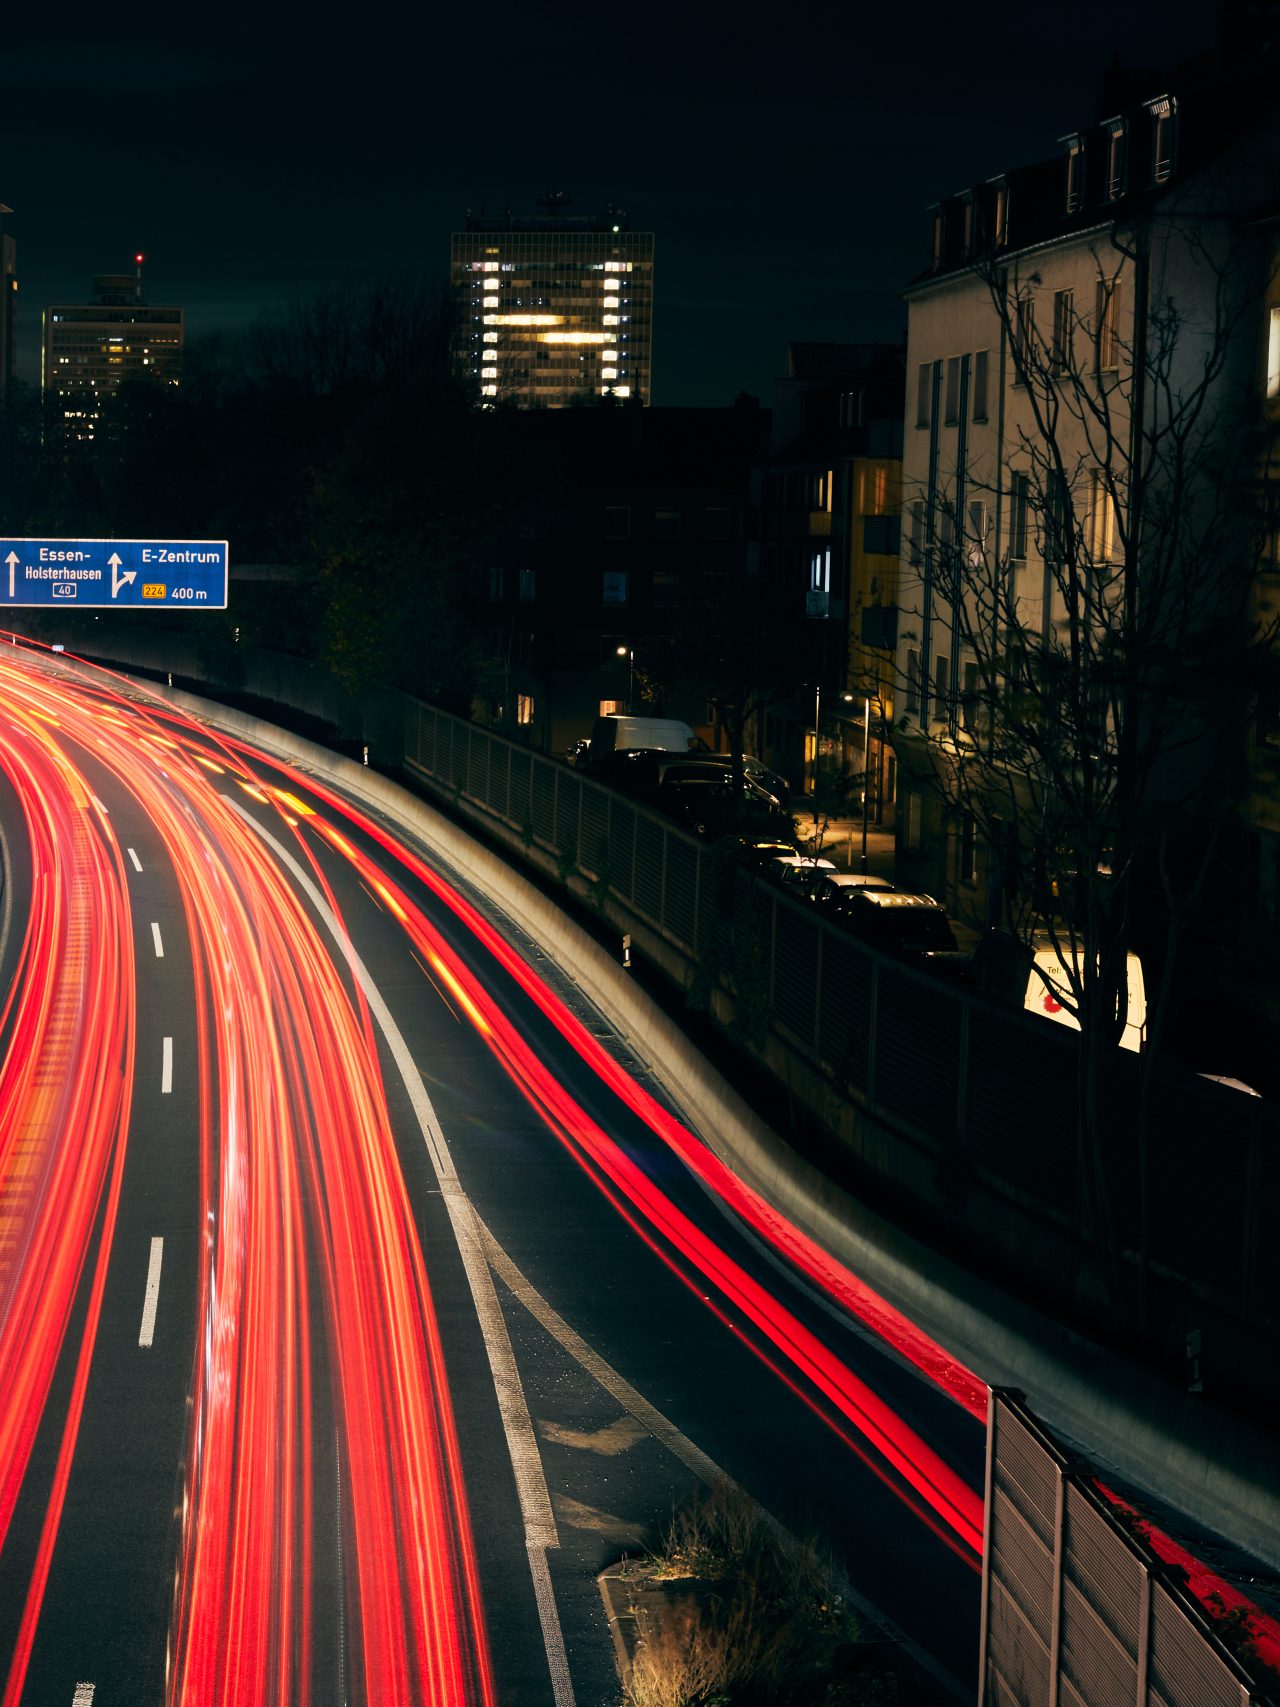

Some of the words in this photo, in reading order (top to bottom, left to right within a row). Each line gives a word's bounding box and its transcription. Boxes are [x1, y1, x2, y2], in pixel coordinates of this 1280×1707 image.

[39, 548, 91, 562] Essen-
[142, 549, 220, 564] E-Zentrum
[25, 566, 102, 580] Holsterhausen
[58, 585, 71, 596] 40
[145, 586, 163, 596] 224
[171, 588, 193, 599] 400
[196, 590, 207, 600] m
[1047, 966, 1062, 975] Tel:
